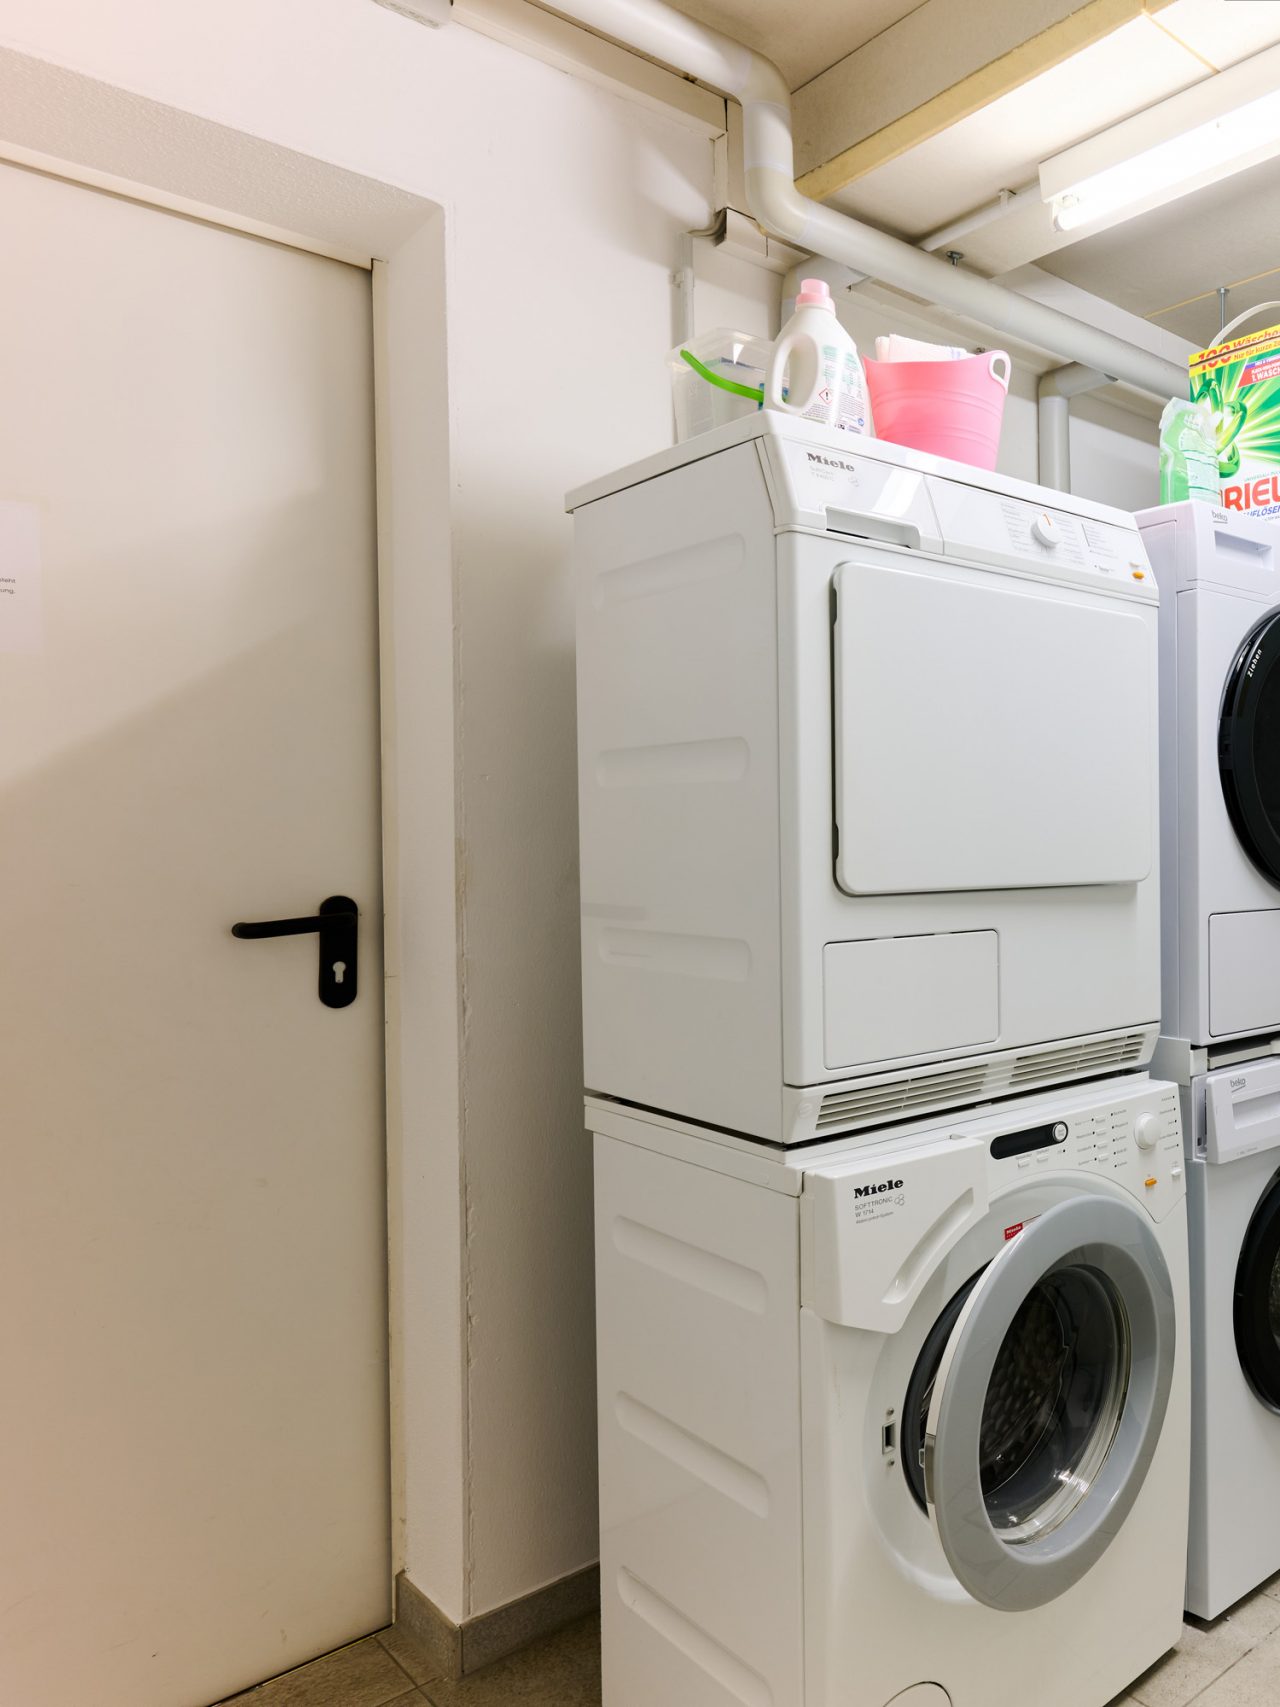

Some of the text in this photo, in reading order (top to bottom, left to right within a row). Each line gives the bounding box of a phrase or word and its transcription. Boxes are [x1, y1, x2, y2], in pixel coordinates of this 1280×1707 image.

[806, 452, 855, 472] Miele
[1247, 649, 1262, 677] Ziehen
[854, 1179, 904, 1199] Miele
